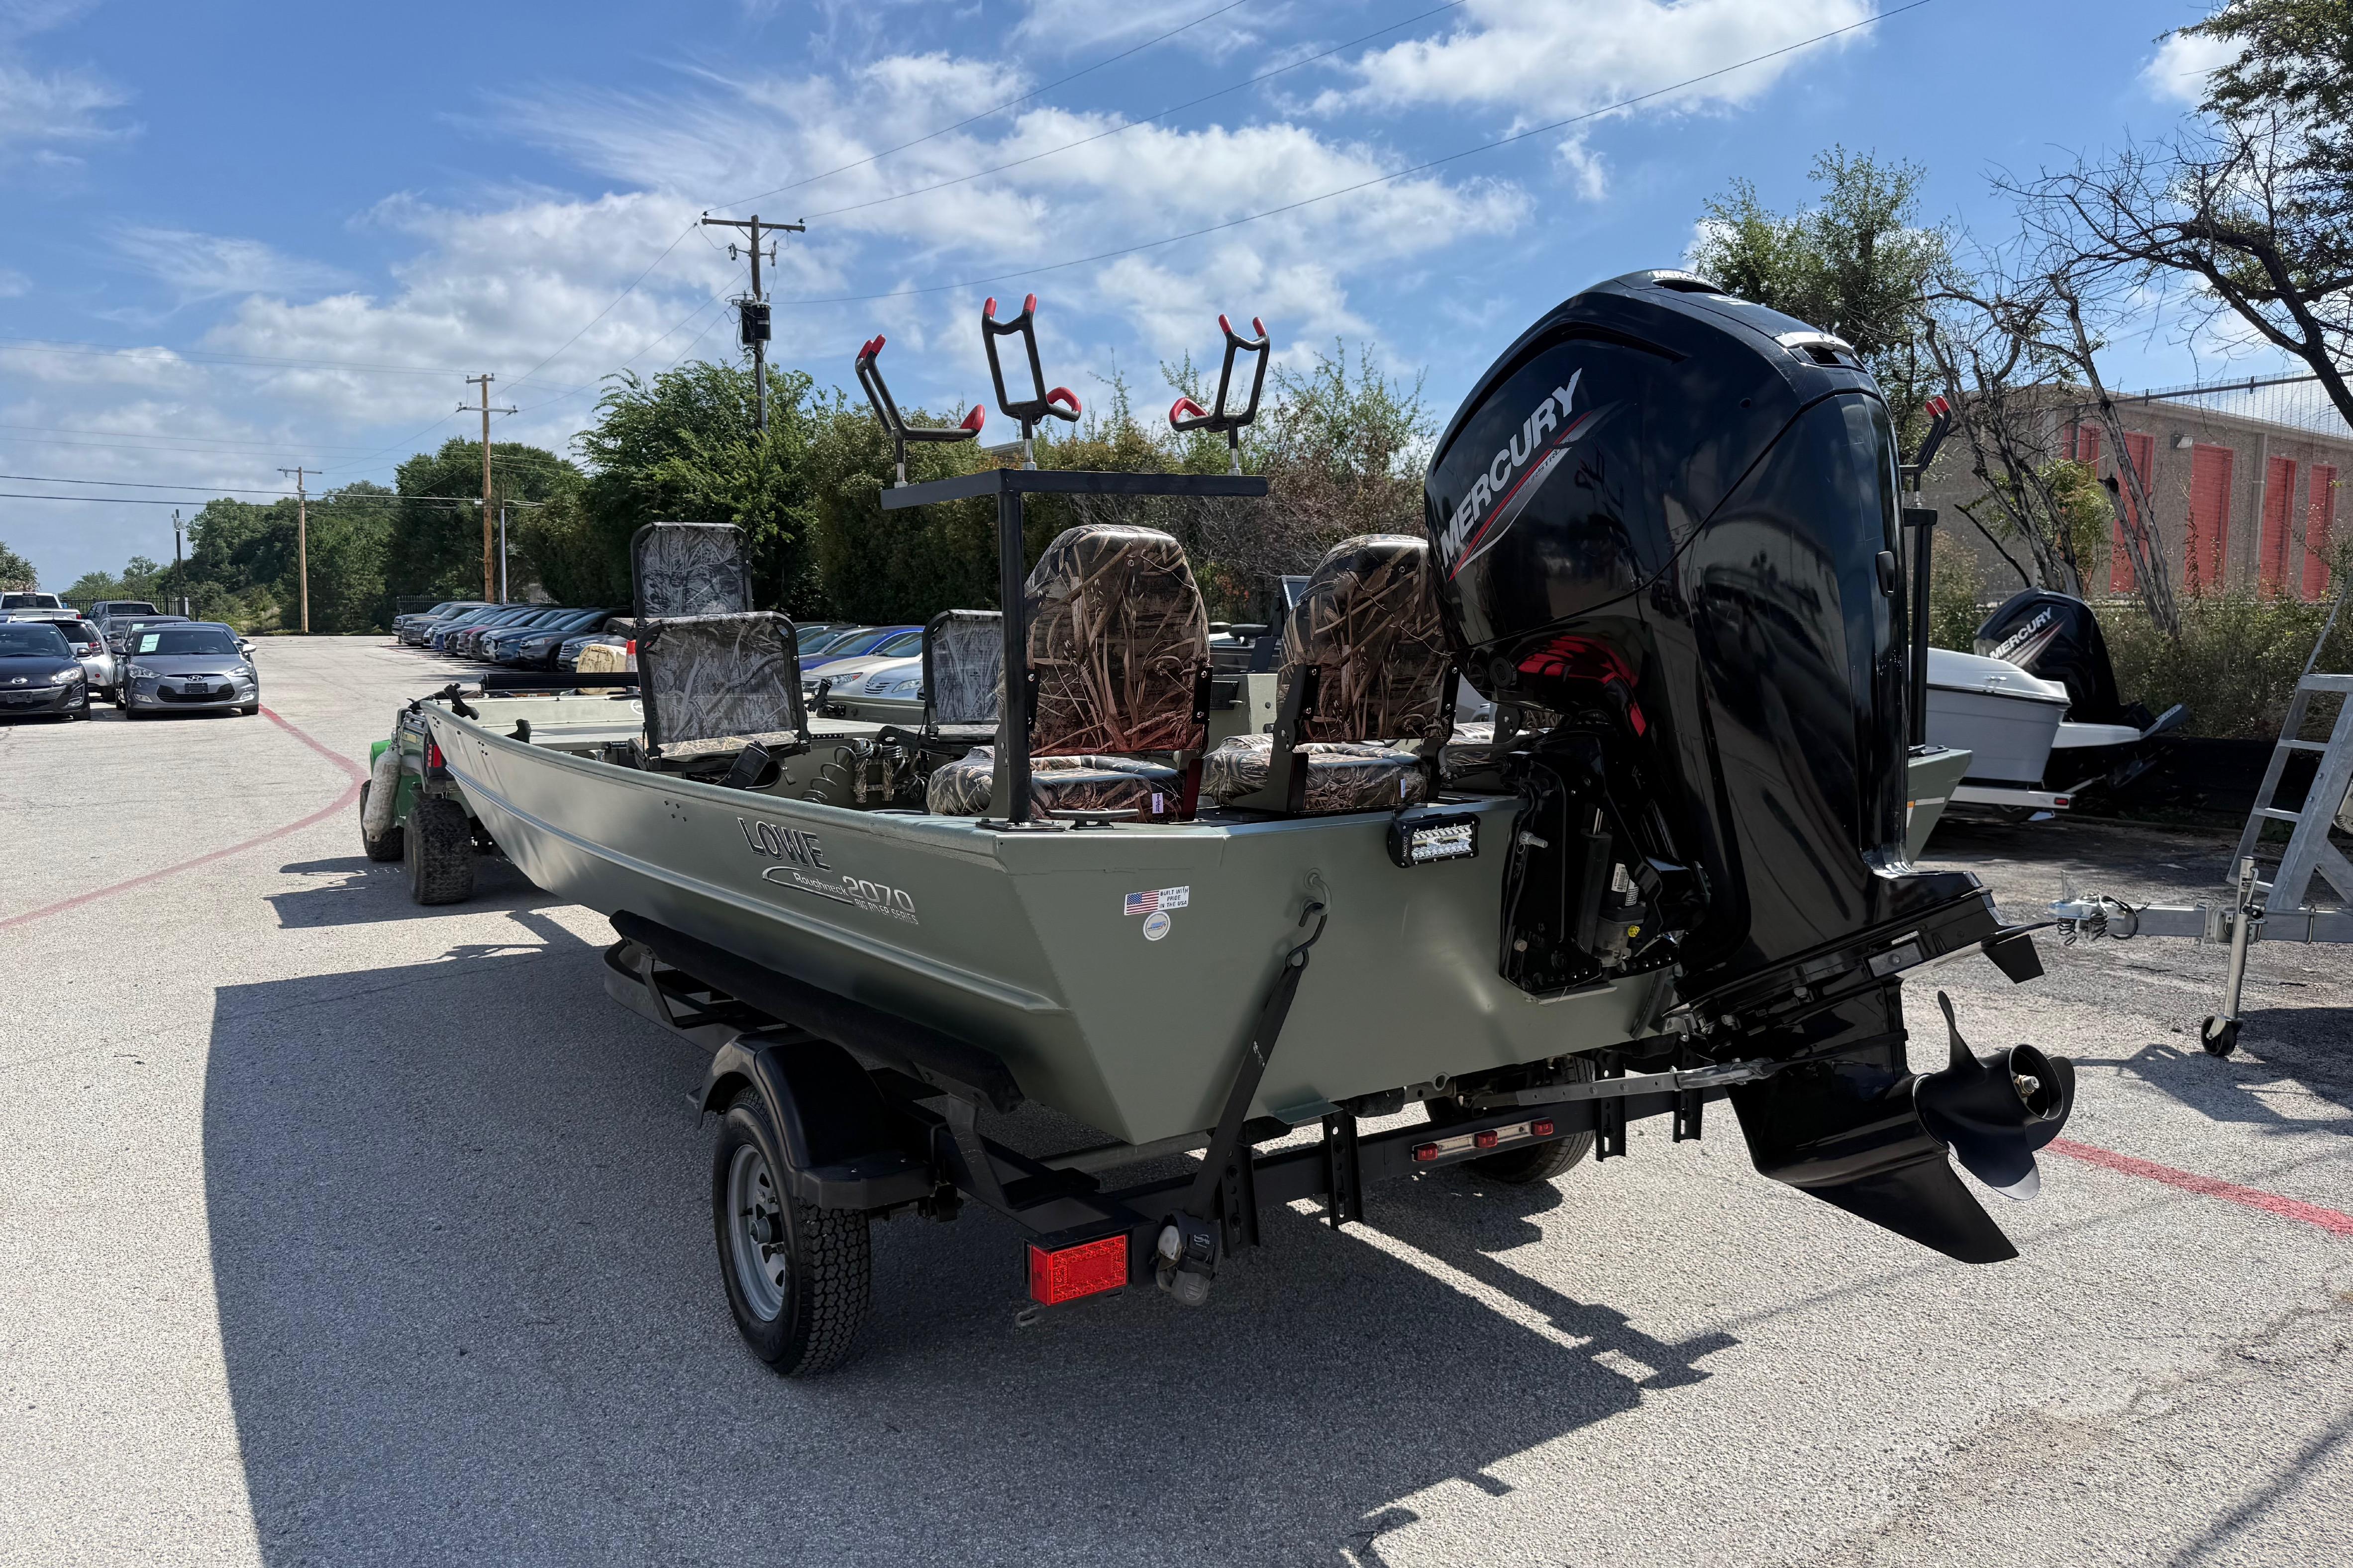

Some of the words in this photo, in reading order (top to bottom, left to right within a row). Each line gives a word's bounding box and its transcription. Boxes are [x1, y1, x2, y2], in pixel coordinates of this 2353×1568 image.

[1440, 368, 1583, 568] MERCURY
[1989, 606, 2051, 660] MERCURY
[737, 817, 833, 873] LOWE
[793, 872, 849, 896] Roughneck
[842, 876, 916, 913] 2070
[854, 898, 868, 910] BIG
[869, 902, 890, 916] RIVER
[891, 908, 919, 925] SERIES
